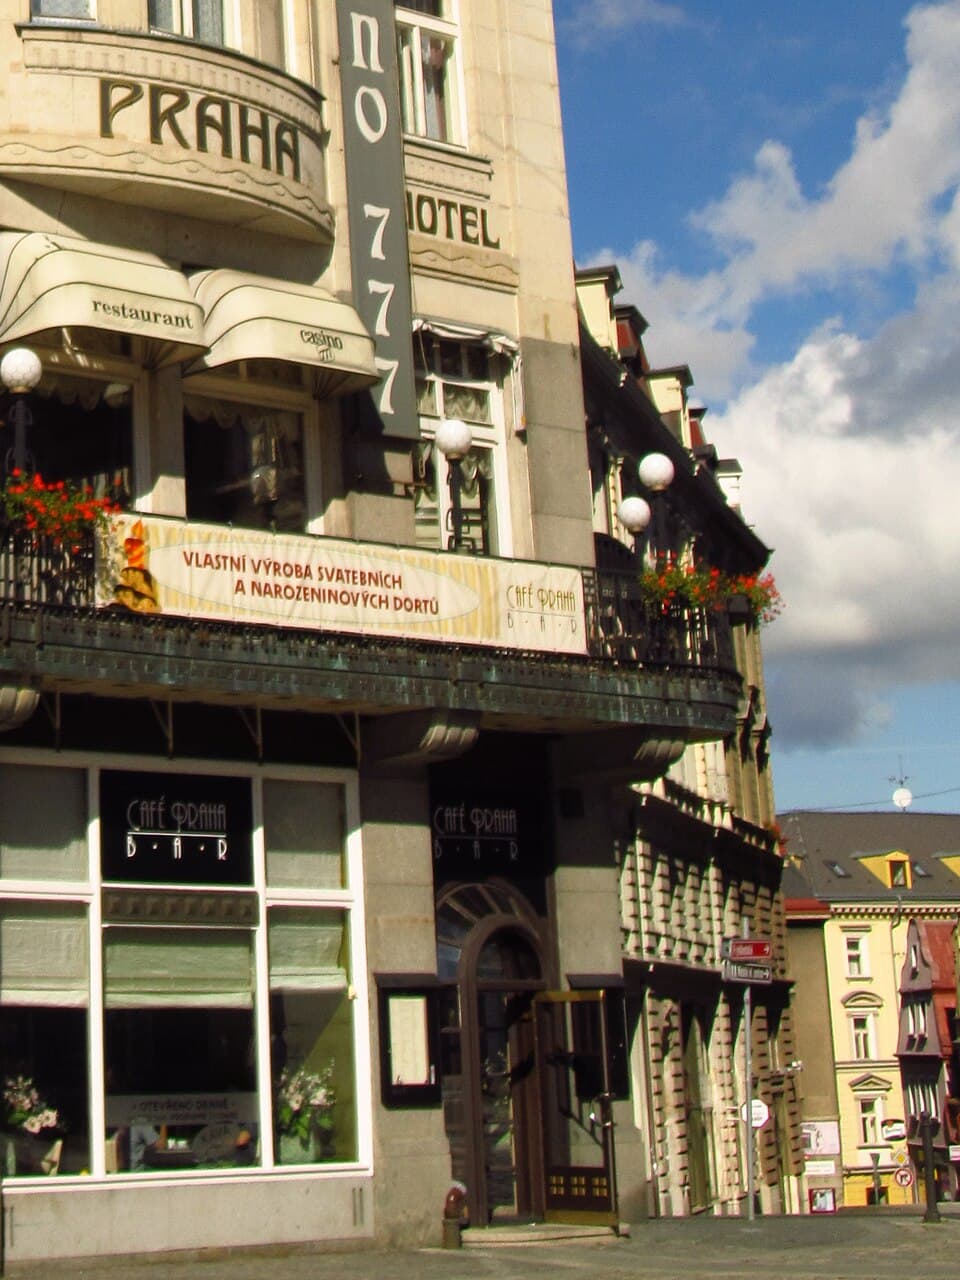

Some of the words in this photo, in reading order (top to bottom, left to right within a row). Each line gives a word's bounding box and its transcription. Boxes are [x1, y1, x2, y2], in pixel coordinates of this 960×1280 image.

[99, 77, 301, 184] PRAHA
[92, 299, 194, 330] restaurant
[300, 329, 344, 351] casino
[182, 550, 247, 573] VLASTNÍ
[251, 558, 314, 582] VÝROBA
[318, 565, 402, 590] SVATEBNÍCH
[234, 578, 246, 596] A
[251, 580, 389, 611] NAROZENINOVÝCH
[394, 595, 440, 616] DORTŮ
[506, 582, 534, 609] CAFÉ
[126, 795, 166, 831] CAFÉ
[170, 802, 227, 833] PRAHA
[434, 802, 467, 834] CAFÉ
[470, 807, 517, 837] PRAHA
